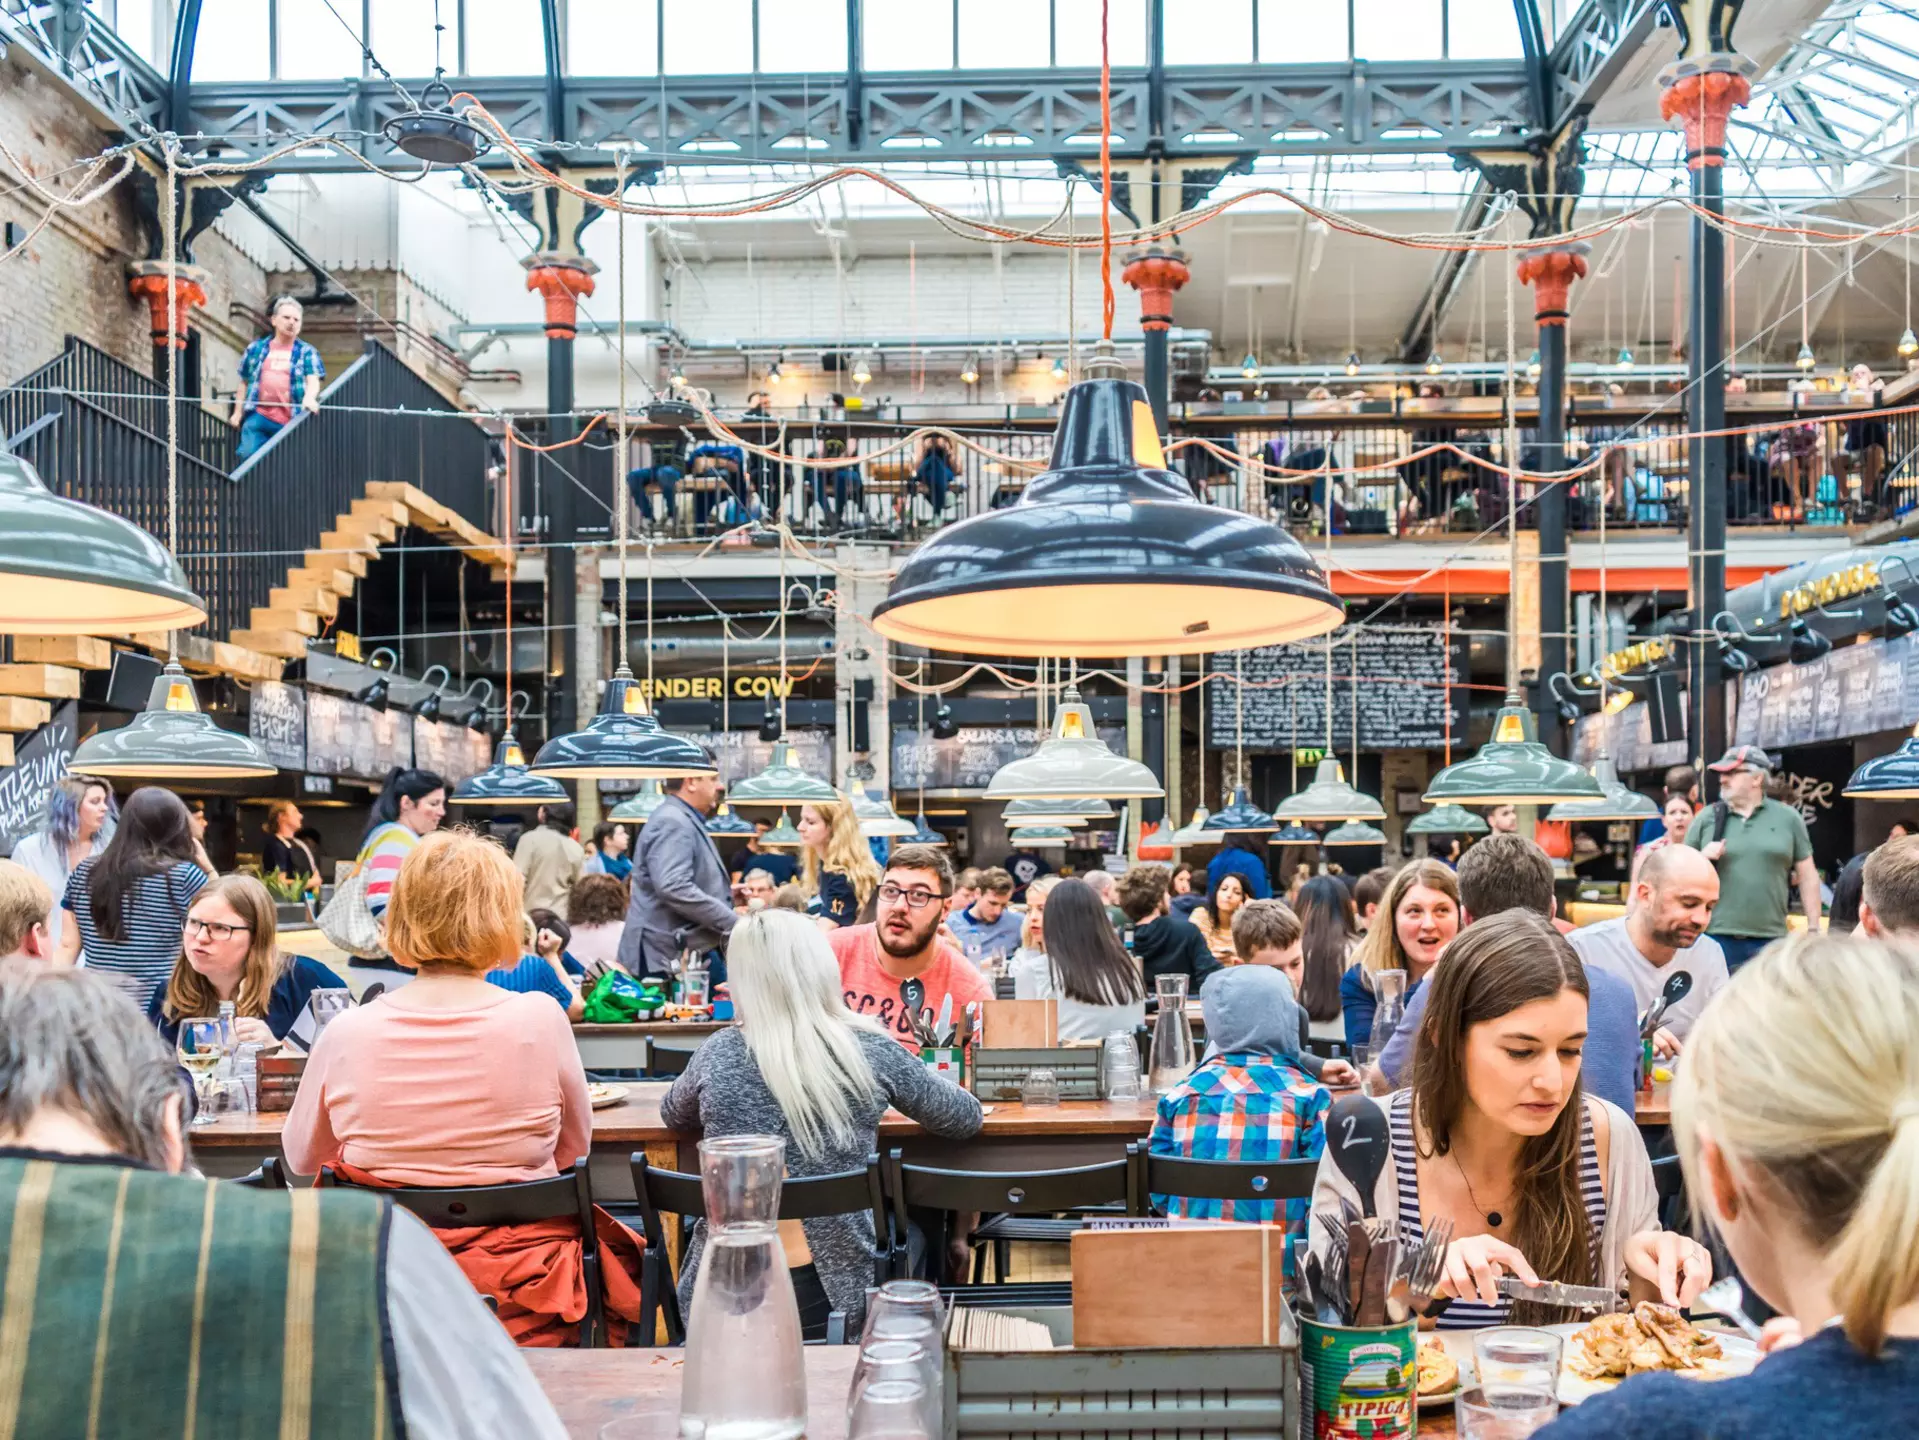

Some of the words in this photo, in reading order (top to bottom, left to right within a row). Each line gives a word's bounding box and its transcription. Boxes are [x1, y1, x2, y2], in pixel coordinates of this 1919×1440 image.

[733, 676, 793, 698] COW
[907, 985, 918, 1001] 5
[1671, 976, 1683, 991] 4
[1341, 1115, 1373, 1150] 2
